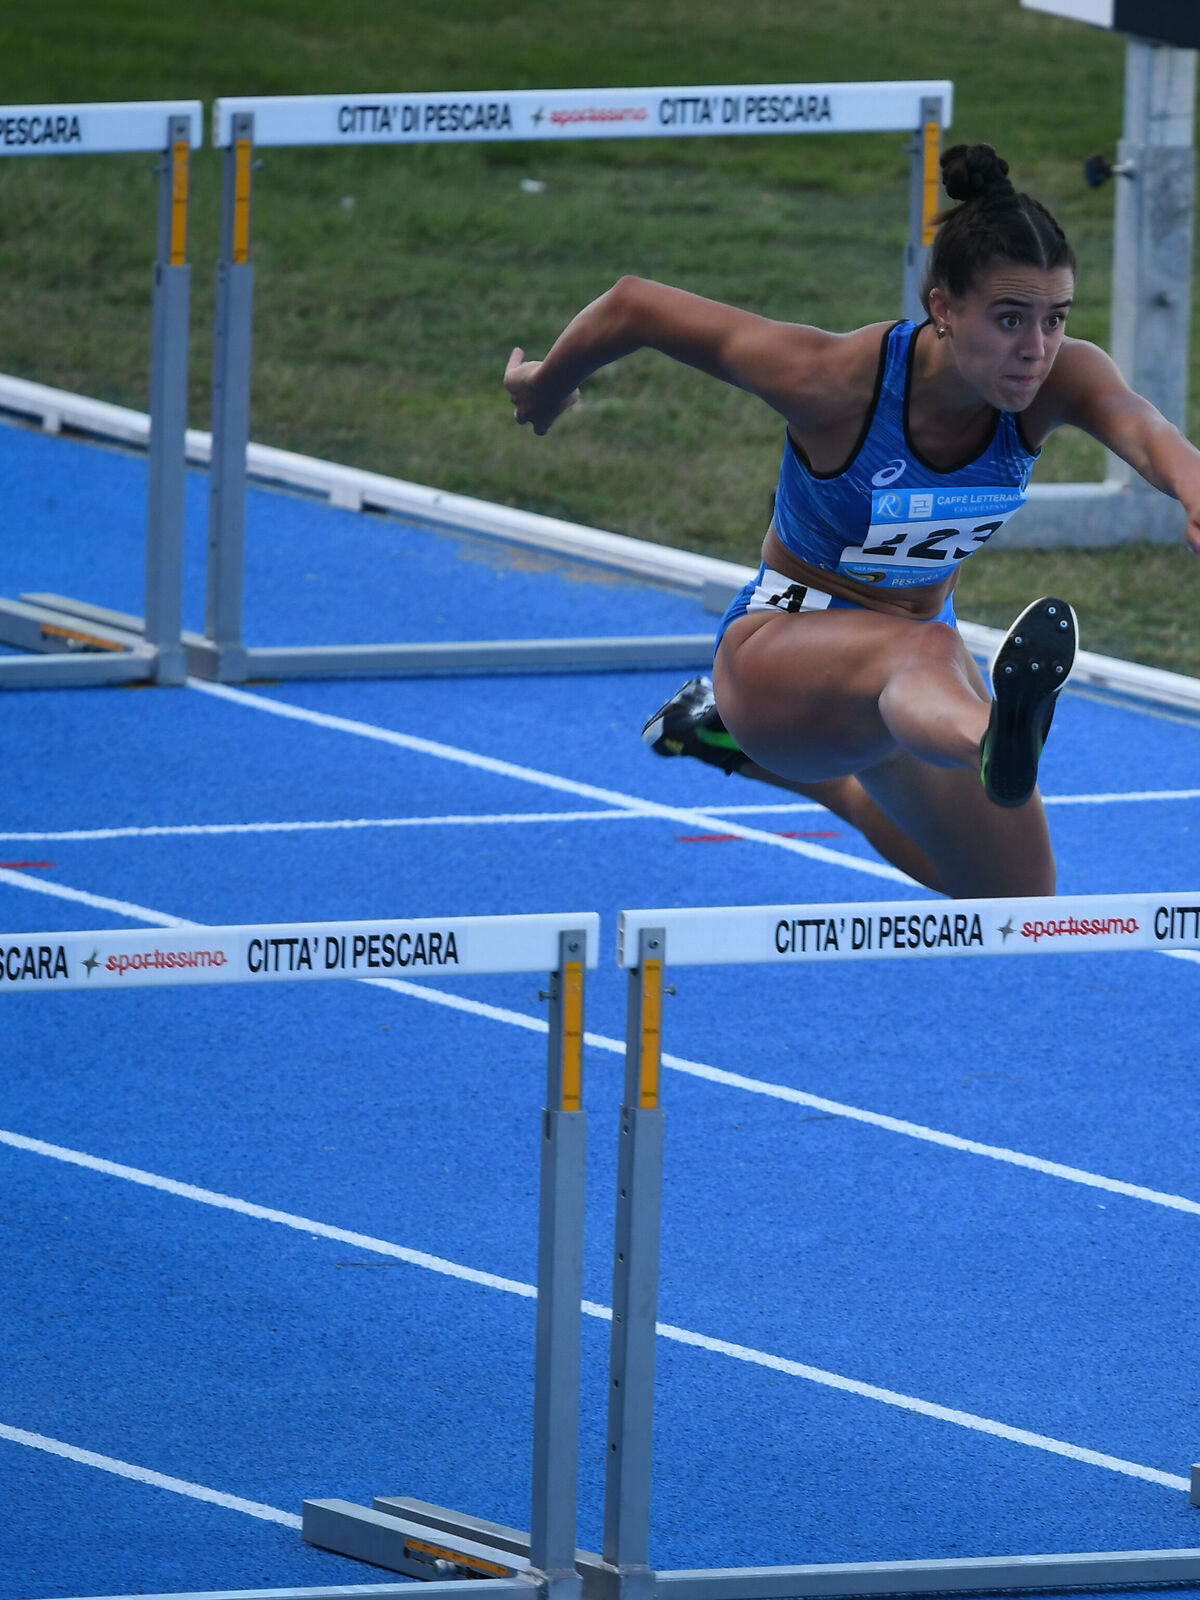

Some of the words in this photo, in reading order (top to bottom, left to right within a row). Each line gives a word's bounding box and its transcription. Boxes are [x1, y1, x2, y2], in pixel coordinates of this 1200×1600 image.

[0, 116, 82, 145] ESCARA
[338, 105, 398, 133] CITTA'
[402, 105, 420, 132] DI
[424, 103, 512, 131] PESCARA
[659, 97, 718, 125] CITTA'
[723, 97, 741, 124] DI
[745, 95, 832, 123] PESCARA
[774, 918, 845, 954] CITTA'
[851, 917, 873, 950] DI
[878, 913, 984, 949] PESCARA
[1020, 915, 1140, 942] sportissimo
[105, 949, 228, 976] sportissimo
[246, 937, 319, 973] CITTA'
[324, 936, 347, 969] DI
[352, 931, 460, 968] PESCARA
